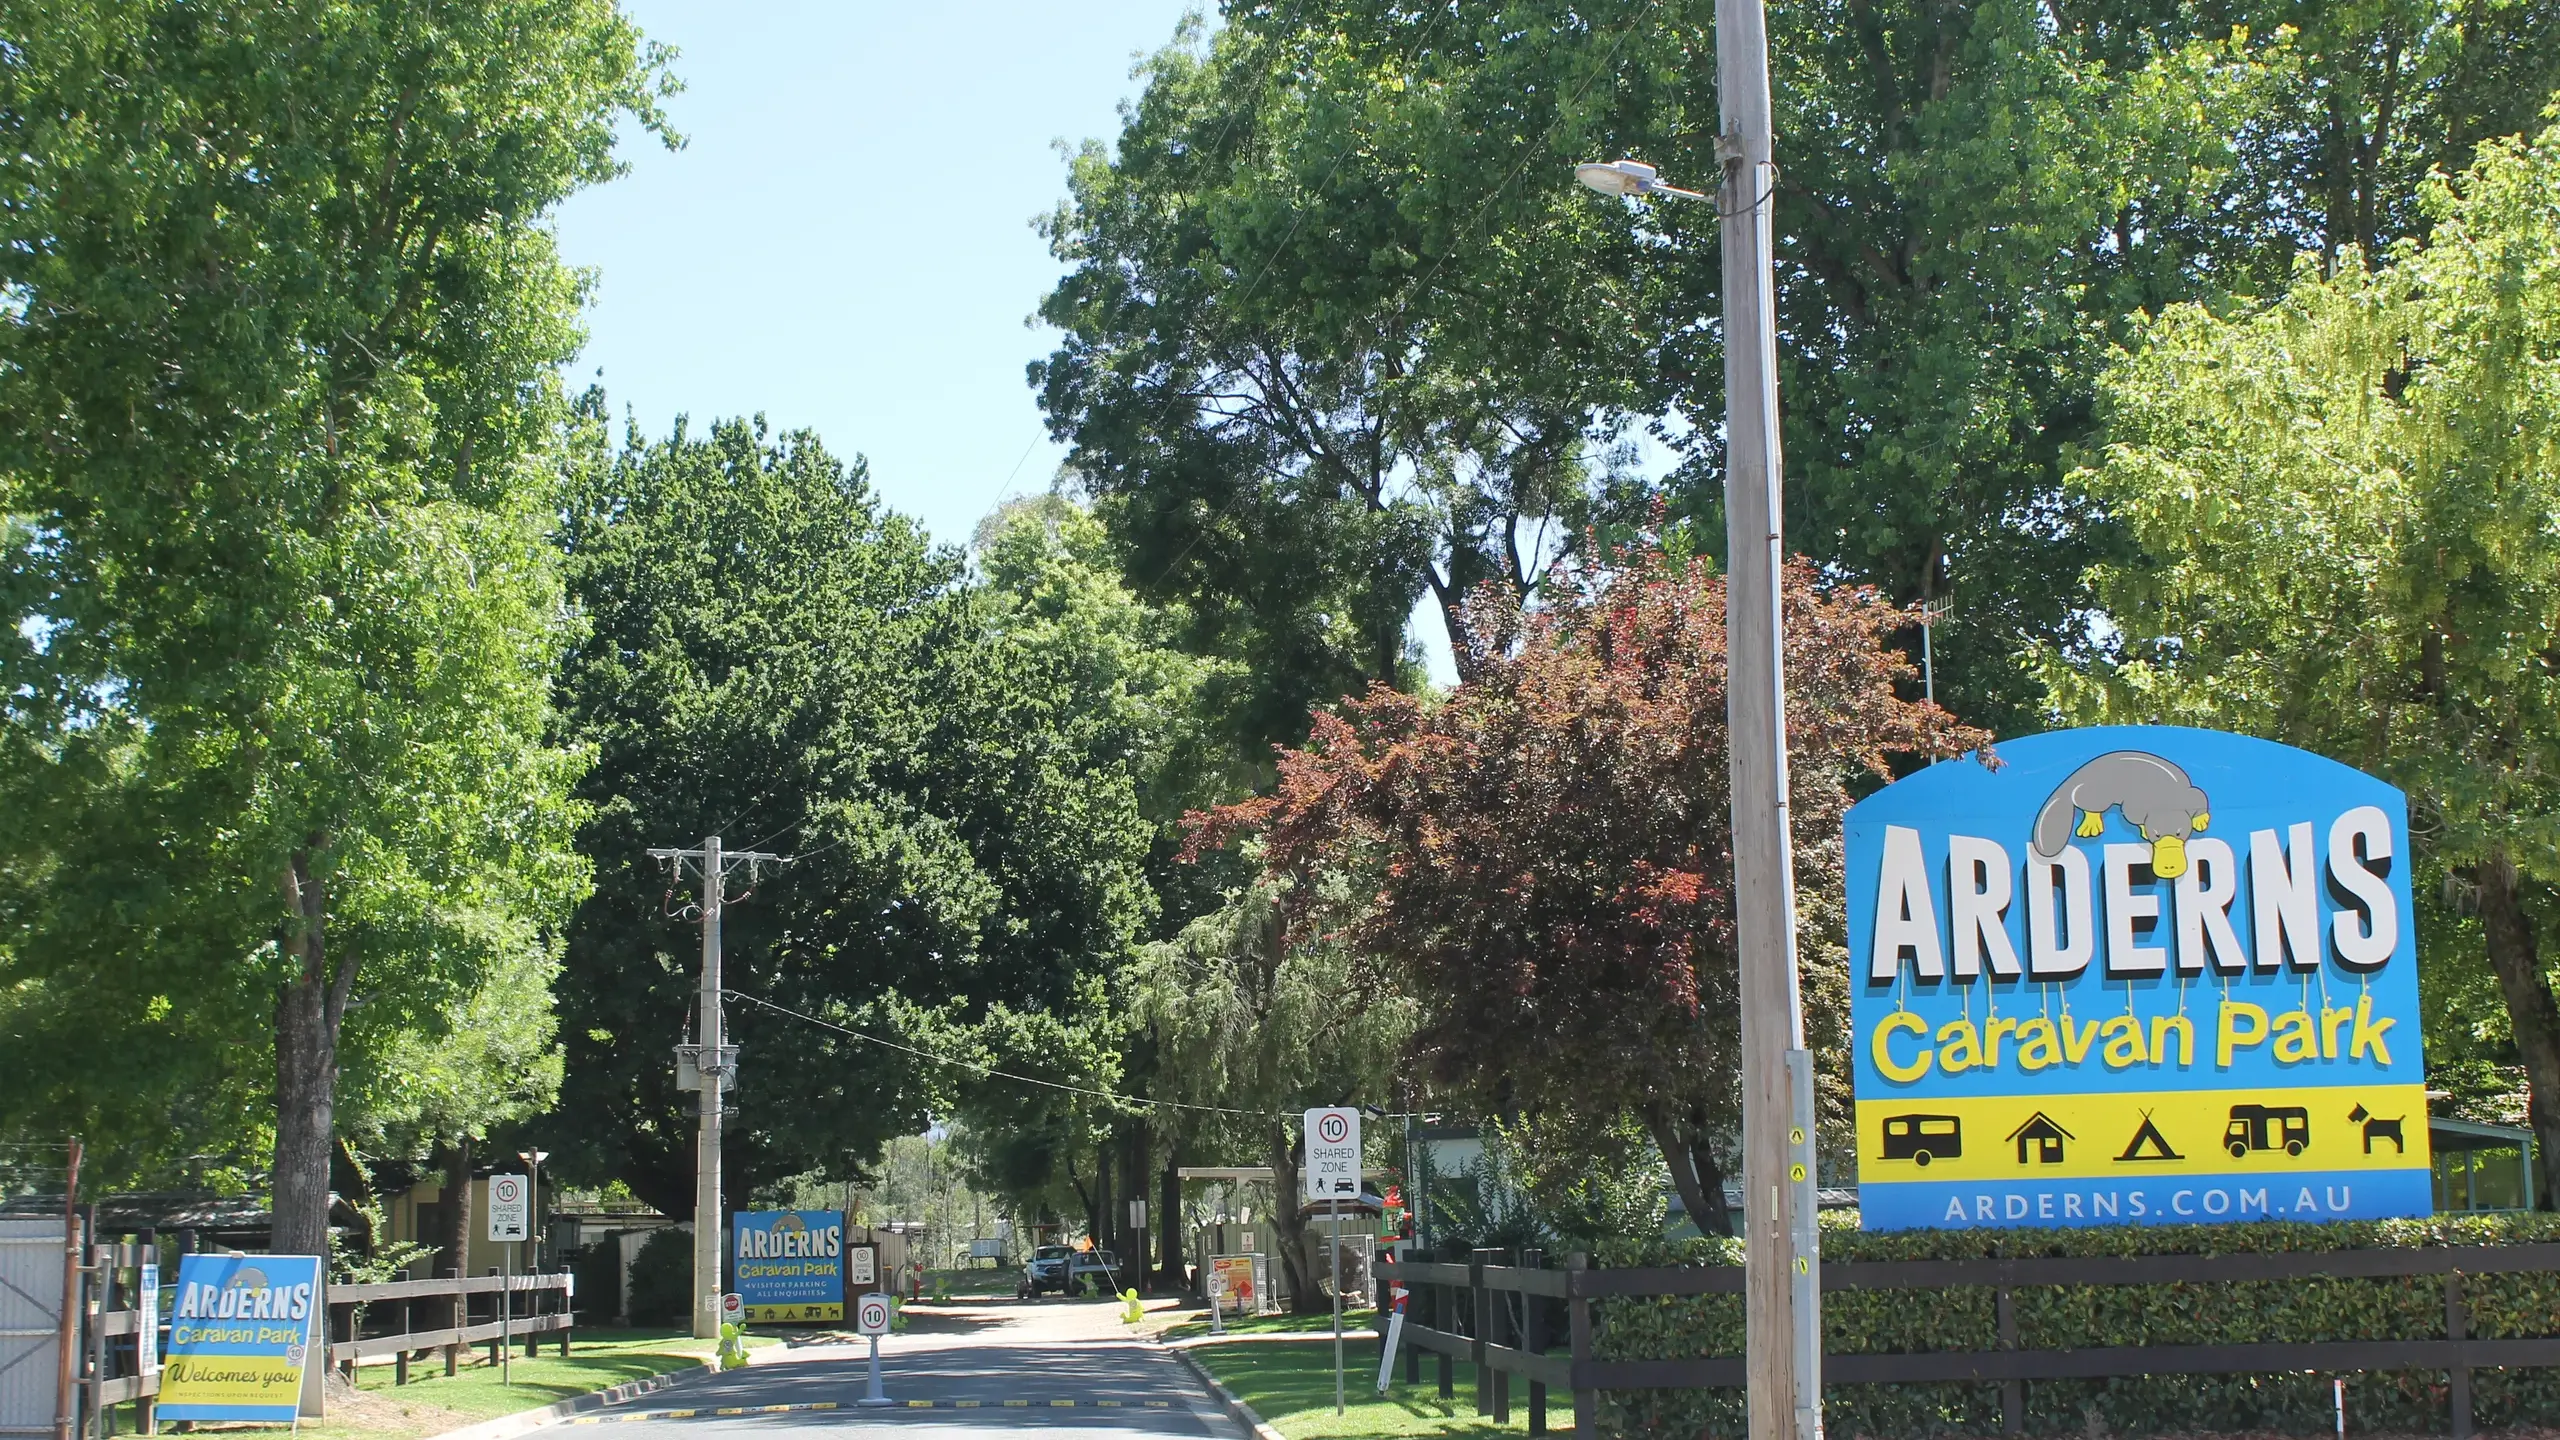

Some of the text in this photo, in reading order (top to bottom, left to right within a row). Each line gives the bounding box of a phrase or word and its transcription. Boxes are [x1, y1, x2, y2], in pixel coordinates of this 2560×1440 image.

[1868, 806, 2398, 987] ARDERNS
[1871, 995, 2398, 1083] Caravan Park
[1324, 1120, 1342, 1136] 10
[1313, 1147, 1355, 1159] SHARED
[1320, 1161, 1348, 1173] ZONE
[500, 1185, 514, 1197] 10
[492, 1204, 522, 1212] SHARED
[1944, 1185, 2351, 1222] ARDERNS.COM.AU
[497, 1214, 517, 1222] ZONE
[739, 1225, 840, 1258] ARDERNS
[738, 1260, 838, 1279] Caravan Park
[749, 1280, 828, 1289] VISITOR PARKING
[179, 1281, 310, 1320] ARDERNS
[773, 1289, 820, 1297] ENQUIRIES
[866, 1310, 881, 1323] 10
[175, 1325, 301, 1346] Caravan Park
[167, 1361, 298, 1389] Welcomes you
